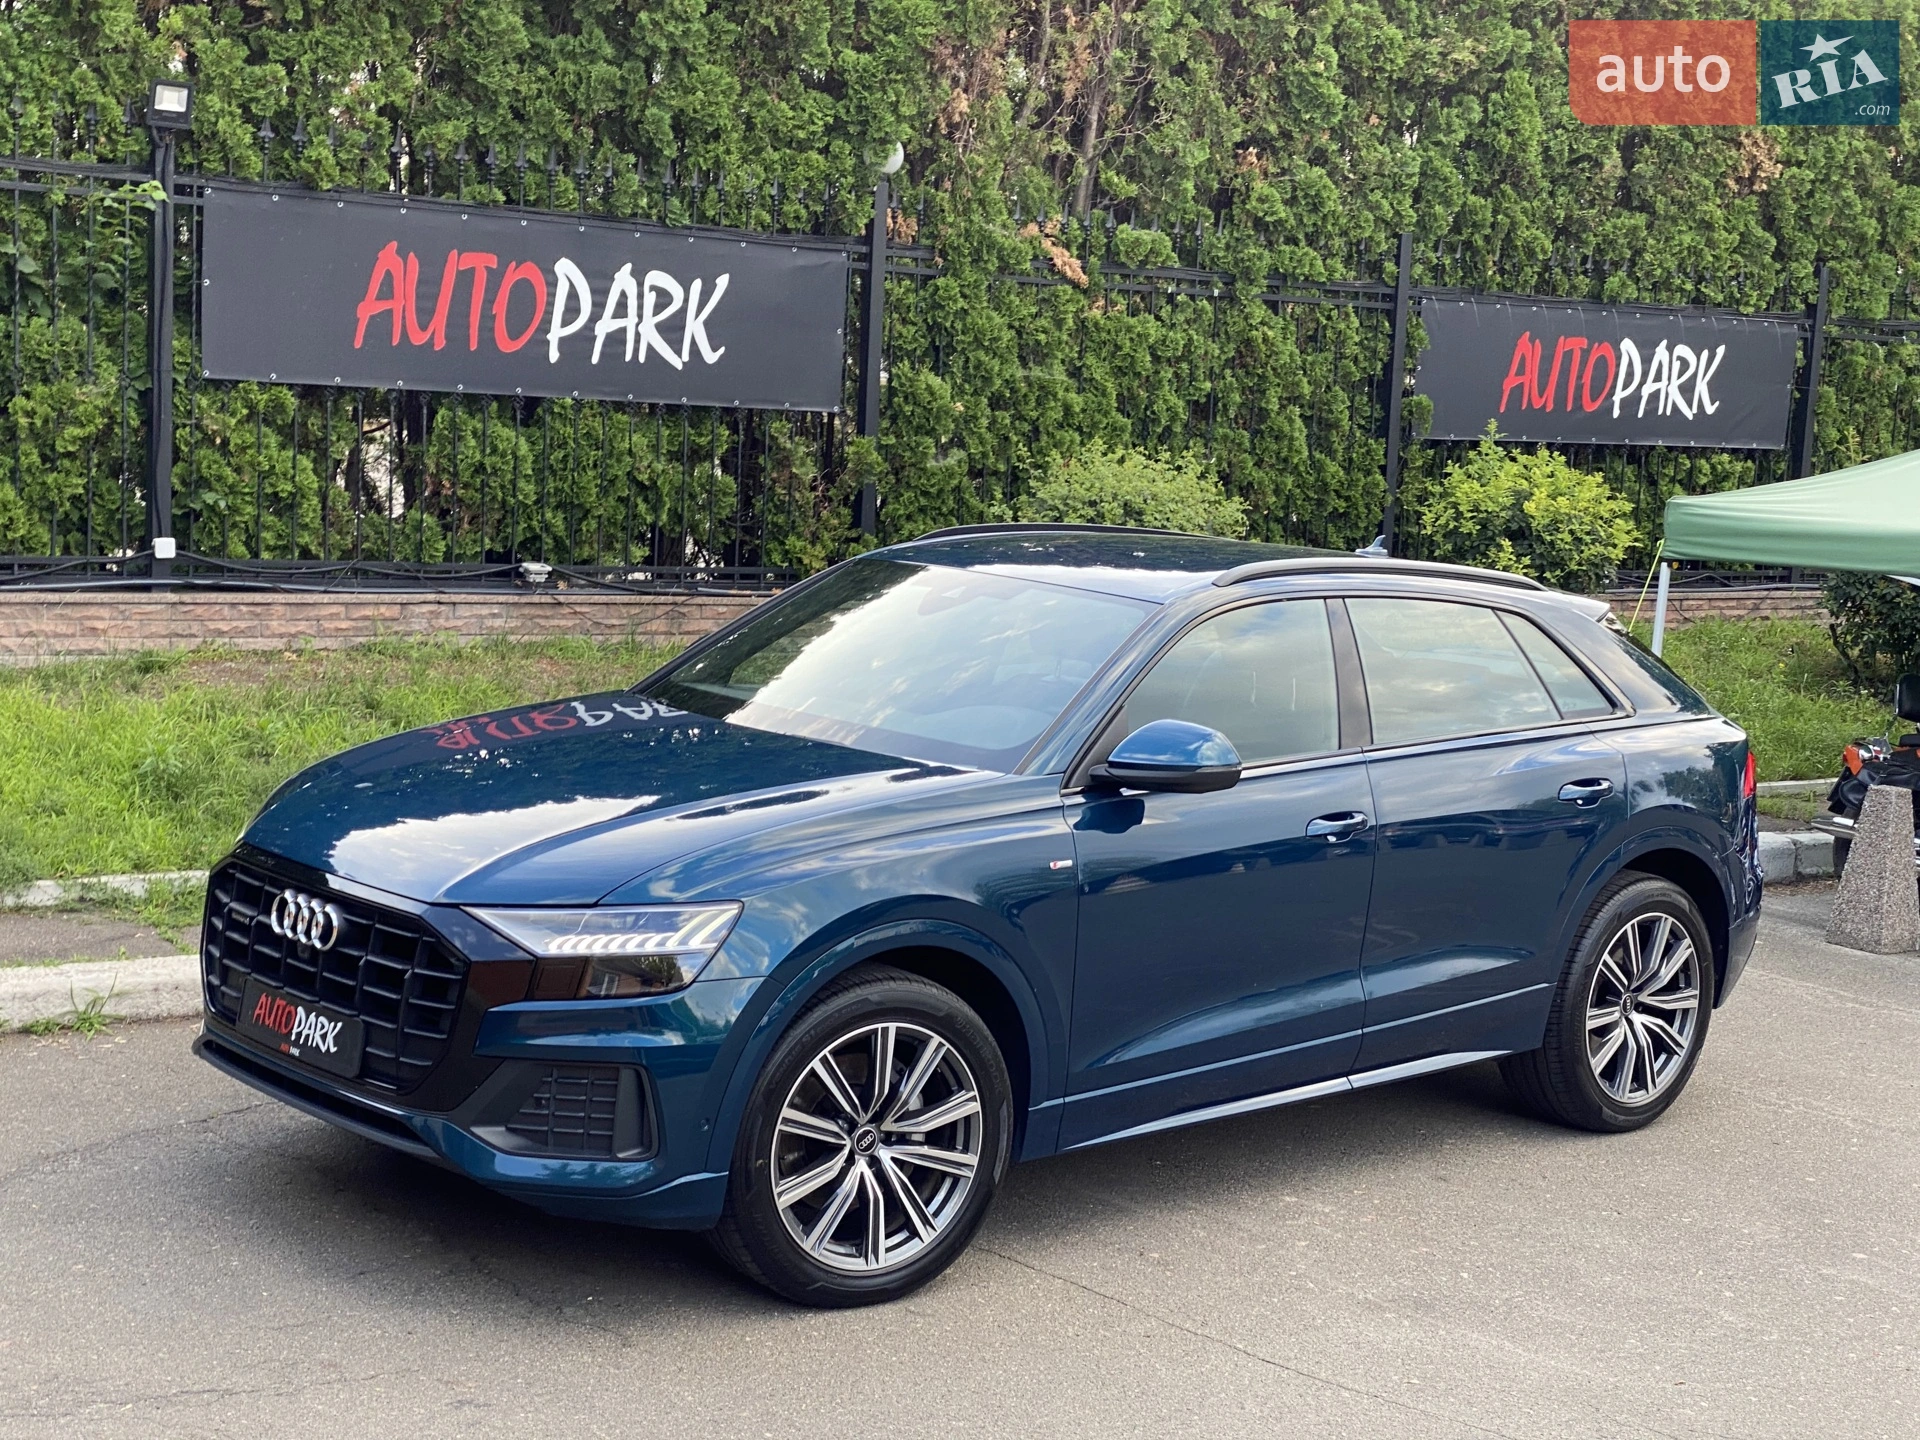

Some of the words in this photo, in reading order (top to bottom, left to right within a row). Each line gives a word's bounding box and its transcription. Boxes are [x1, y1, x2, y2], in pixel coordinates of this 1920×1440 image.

[353, 240, 729, 370] AUTOPARK
[1500, 331, 1726, 420] AUTOPARK
[252, 992, 343, 1053] AUTOPARK
